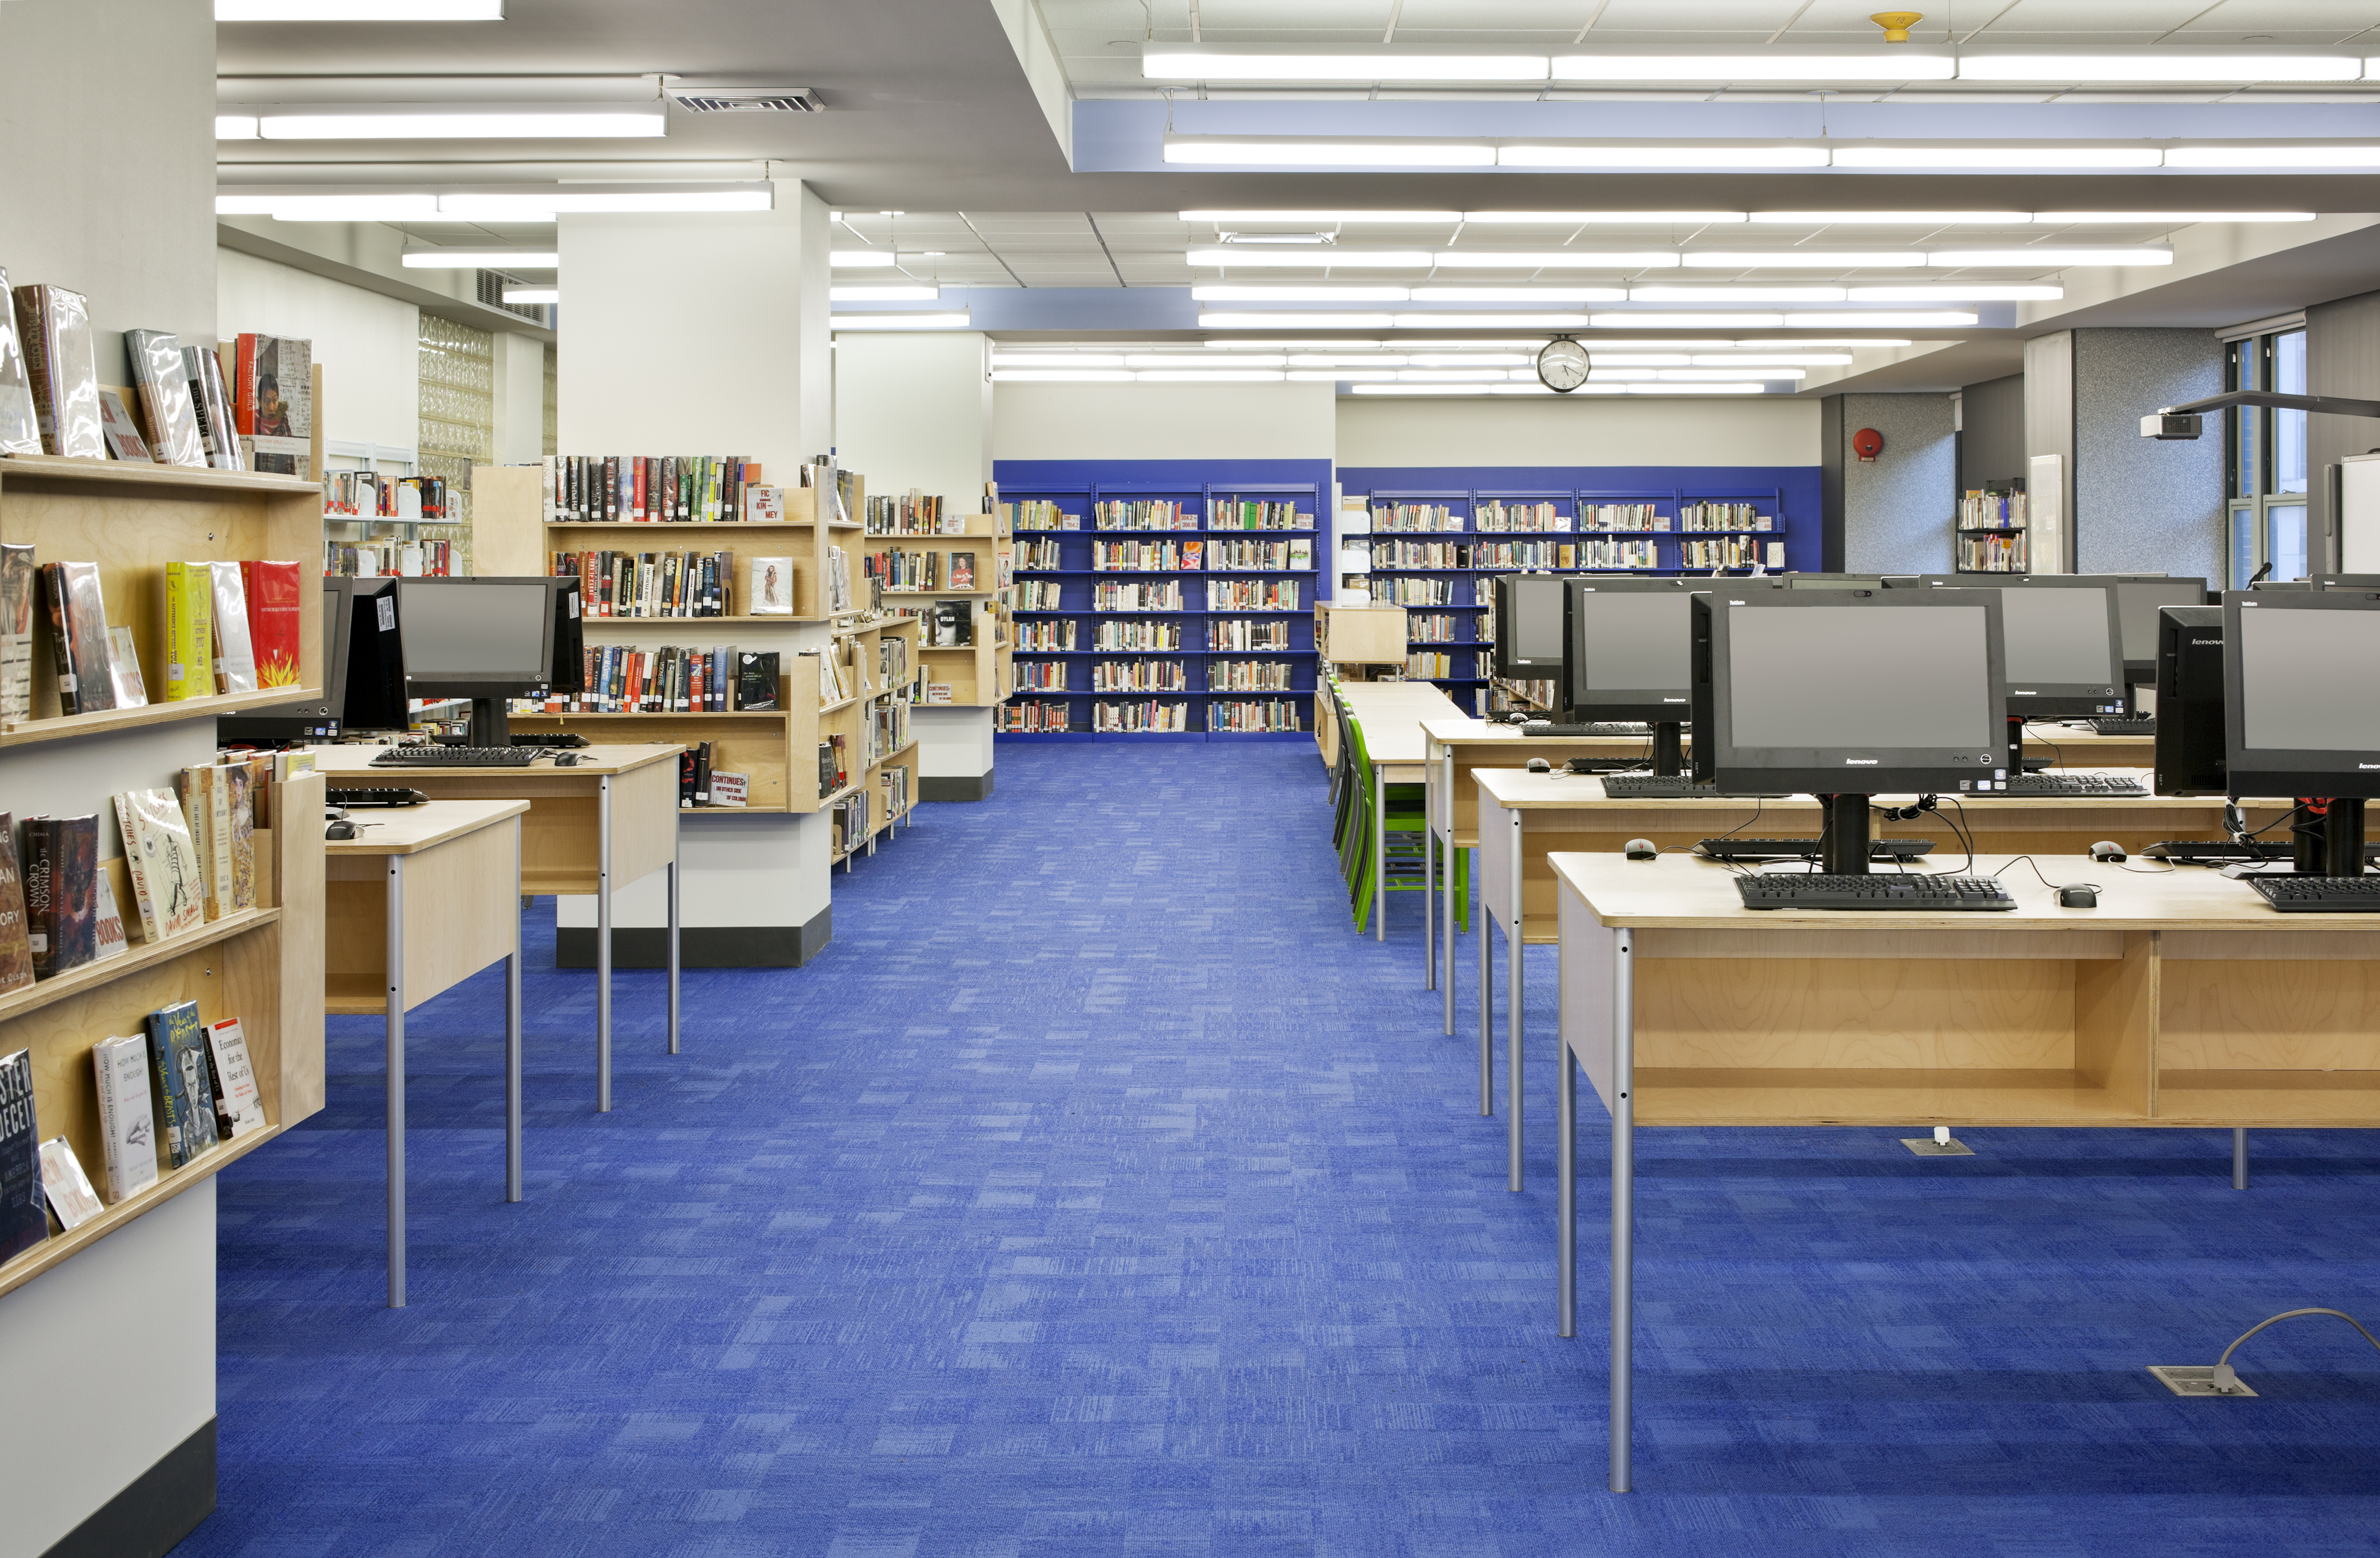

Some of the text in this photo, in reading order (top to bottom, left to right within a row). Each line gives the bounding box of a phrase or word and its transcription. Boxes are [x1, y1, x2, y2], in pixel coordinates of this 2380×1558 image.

[29, 312, 38, 343] JOSEPH
[141, 385, 150, 408] Normal?
[195, 403, 209, 437] SPEEC
[115, 433, 149, 458] BOOKS
[620, 460, 628, 483] KING
[649, 470, 659, 490] KING
[51, 570, 59, 600] ANDERSON
[196, 636, 205, 648] YOU
[711, 775, 744, 786] CONTINUES
[215, 809, 227, 818] INSIGHT
[118, 806, 137, 846] STITCHES
[27, 864, 40, 908] CROWN
[38, 846, 50, 916] THE CRIMSON
[132, 870, 148, 896] DAVID
[219, 883, 230, 893] KANDEL
[165, 901, 199, 937] DAVID SMALL
[96, 916, 124, 946] BOOKS
[8, 972, 29, 983] OLSON
[174, 1012, 188, 1026] Year
[170, 1020, 199, 1043] BEASTS
[219, 1035, 243, 1050] Economics
[202, 1032, 210, 1055] Economics
[117, 1058, 129, 1069] HOW
[130, 1053, 143, 1064] MUCH
[105, 1073, 113, 1095] MUCH
[227, 1065, 250, 1082] Rest of Us
[159, 1066, 176, 1124] Year BEASTS
[108, 1104, 117, 1138] ENOUGH?
[12, 1190, 27, 1208] LIES
[62, 1186, 99, 1218] BOOKS
